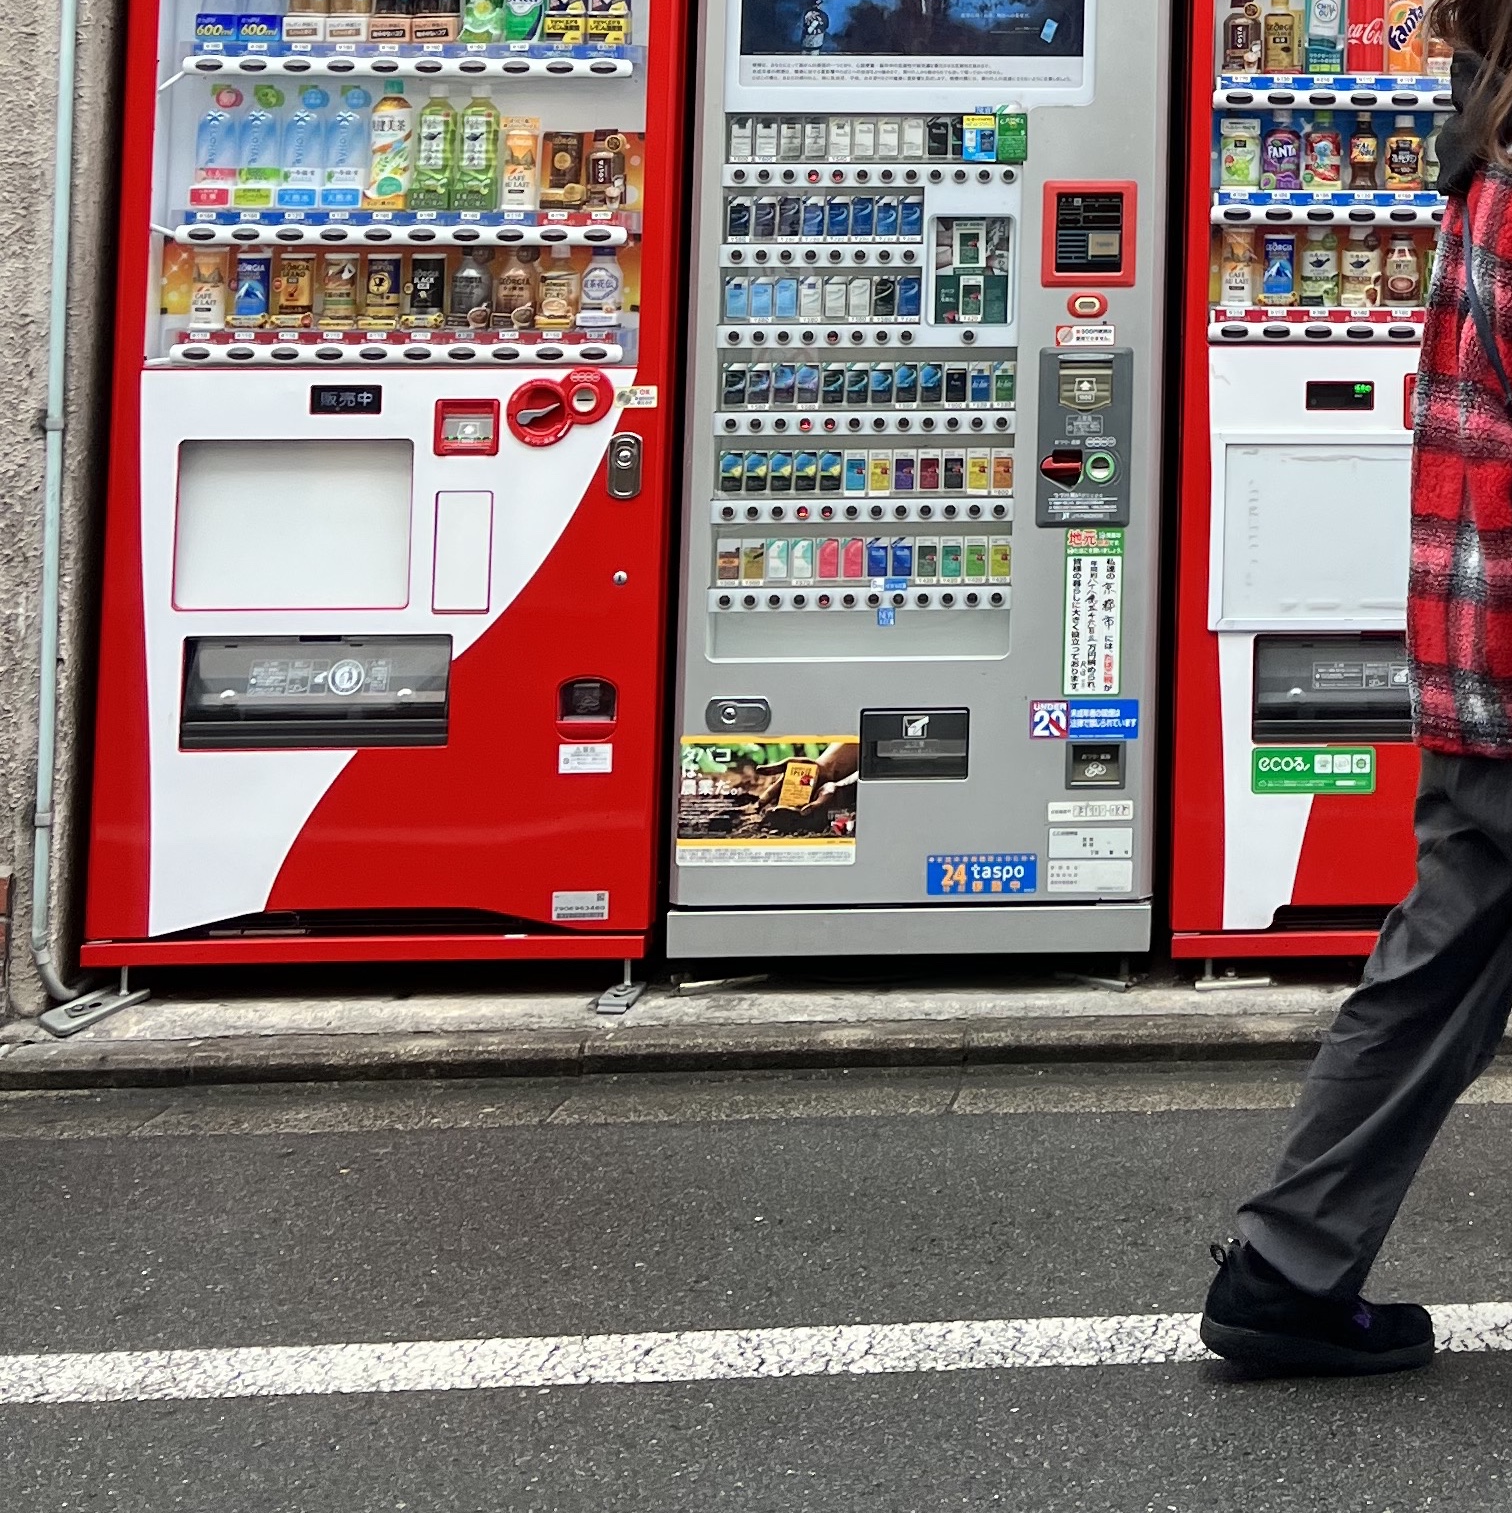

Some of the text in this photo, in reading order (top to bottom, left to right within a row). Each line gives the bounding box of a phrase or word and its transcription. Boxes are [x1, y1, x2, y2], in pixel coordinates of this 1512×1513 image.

[196, 24, 234, 36] 600ml
[240, 24, 278, 36] 600ml
[1388, 5, 1424, 51] Fanta
[1267, 144, 1296, 158] FANTA
[414, 276, 435, 284] BLACK
[321, 391, 373, 407] 販売中
[1068, 529, 1097, 546] 地元
[1033, 702, 1067, 711] UNDER
[1033, 711, 1067, 736] 20
[682, 746, 731, 762] タバコ
[682, 764, 703, 778] は、
[941, 863, 967, 887] 24
[970, 864, 1025, 882] taspo
